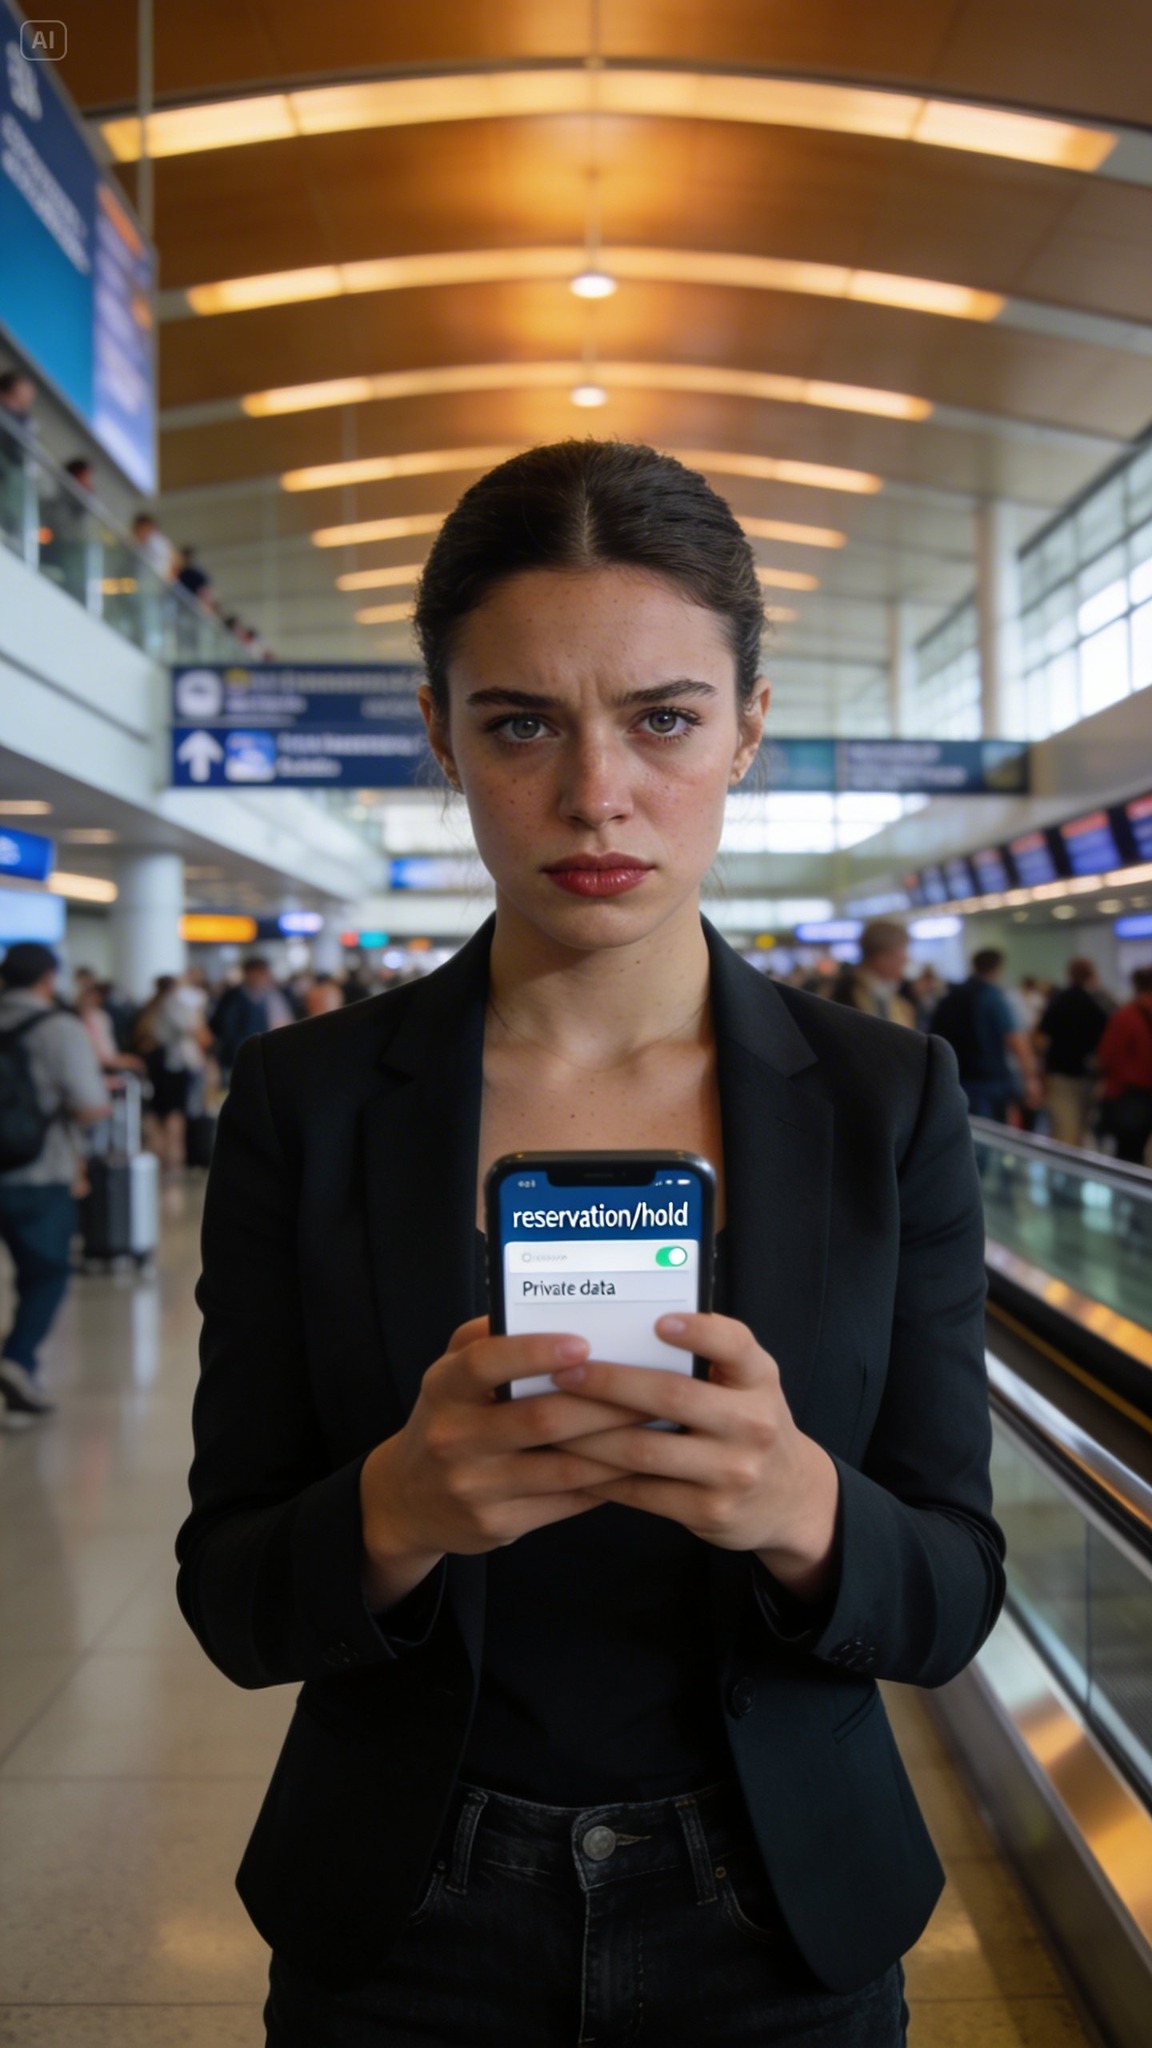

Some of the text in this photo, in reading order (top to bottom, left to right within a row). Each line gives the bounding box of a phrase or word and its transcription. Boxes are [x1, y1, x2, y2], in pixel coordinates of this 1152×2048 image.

[513, 1202, 688, 1230] reservation/hold
[523, 1280, 616, 1296] Private data
